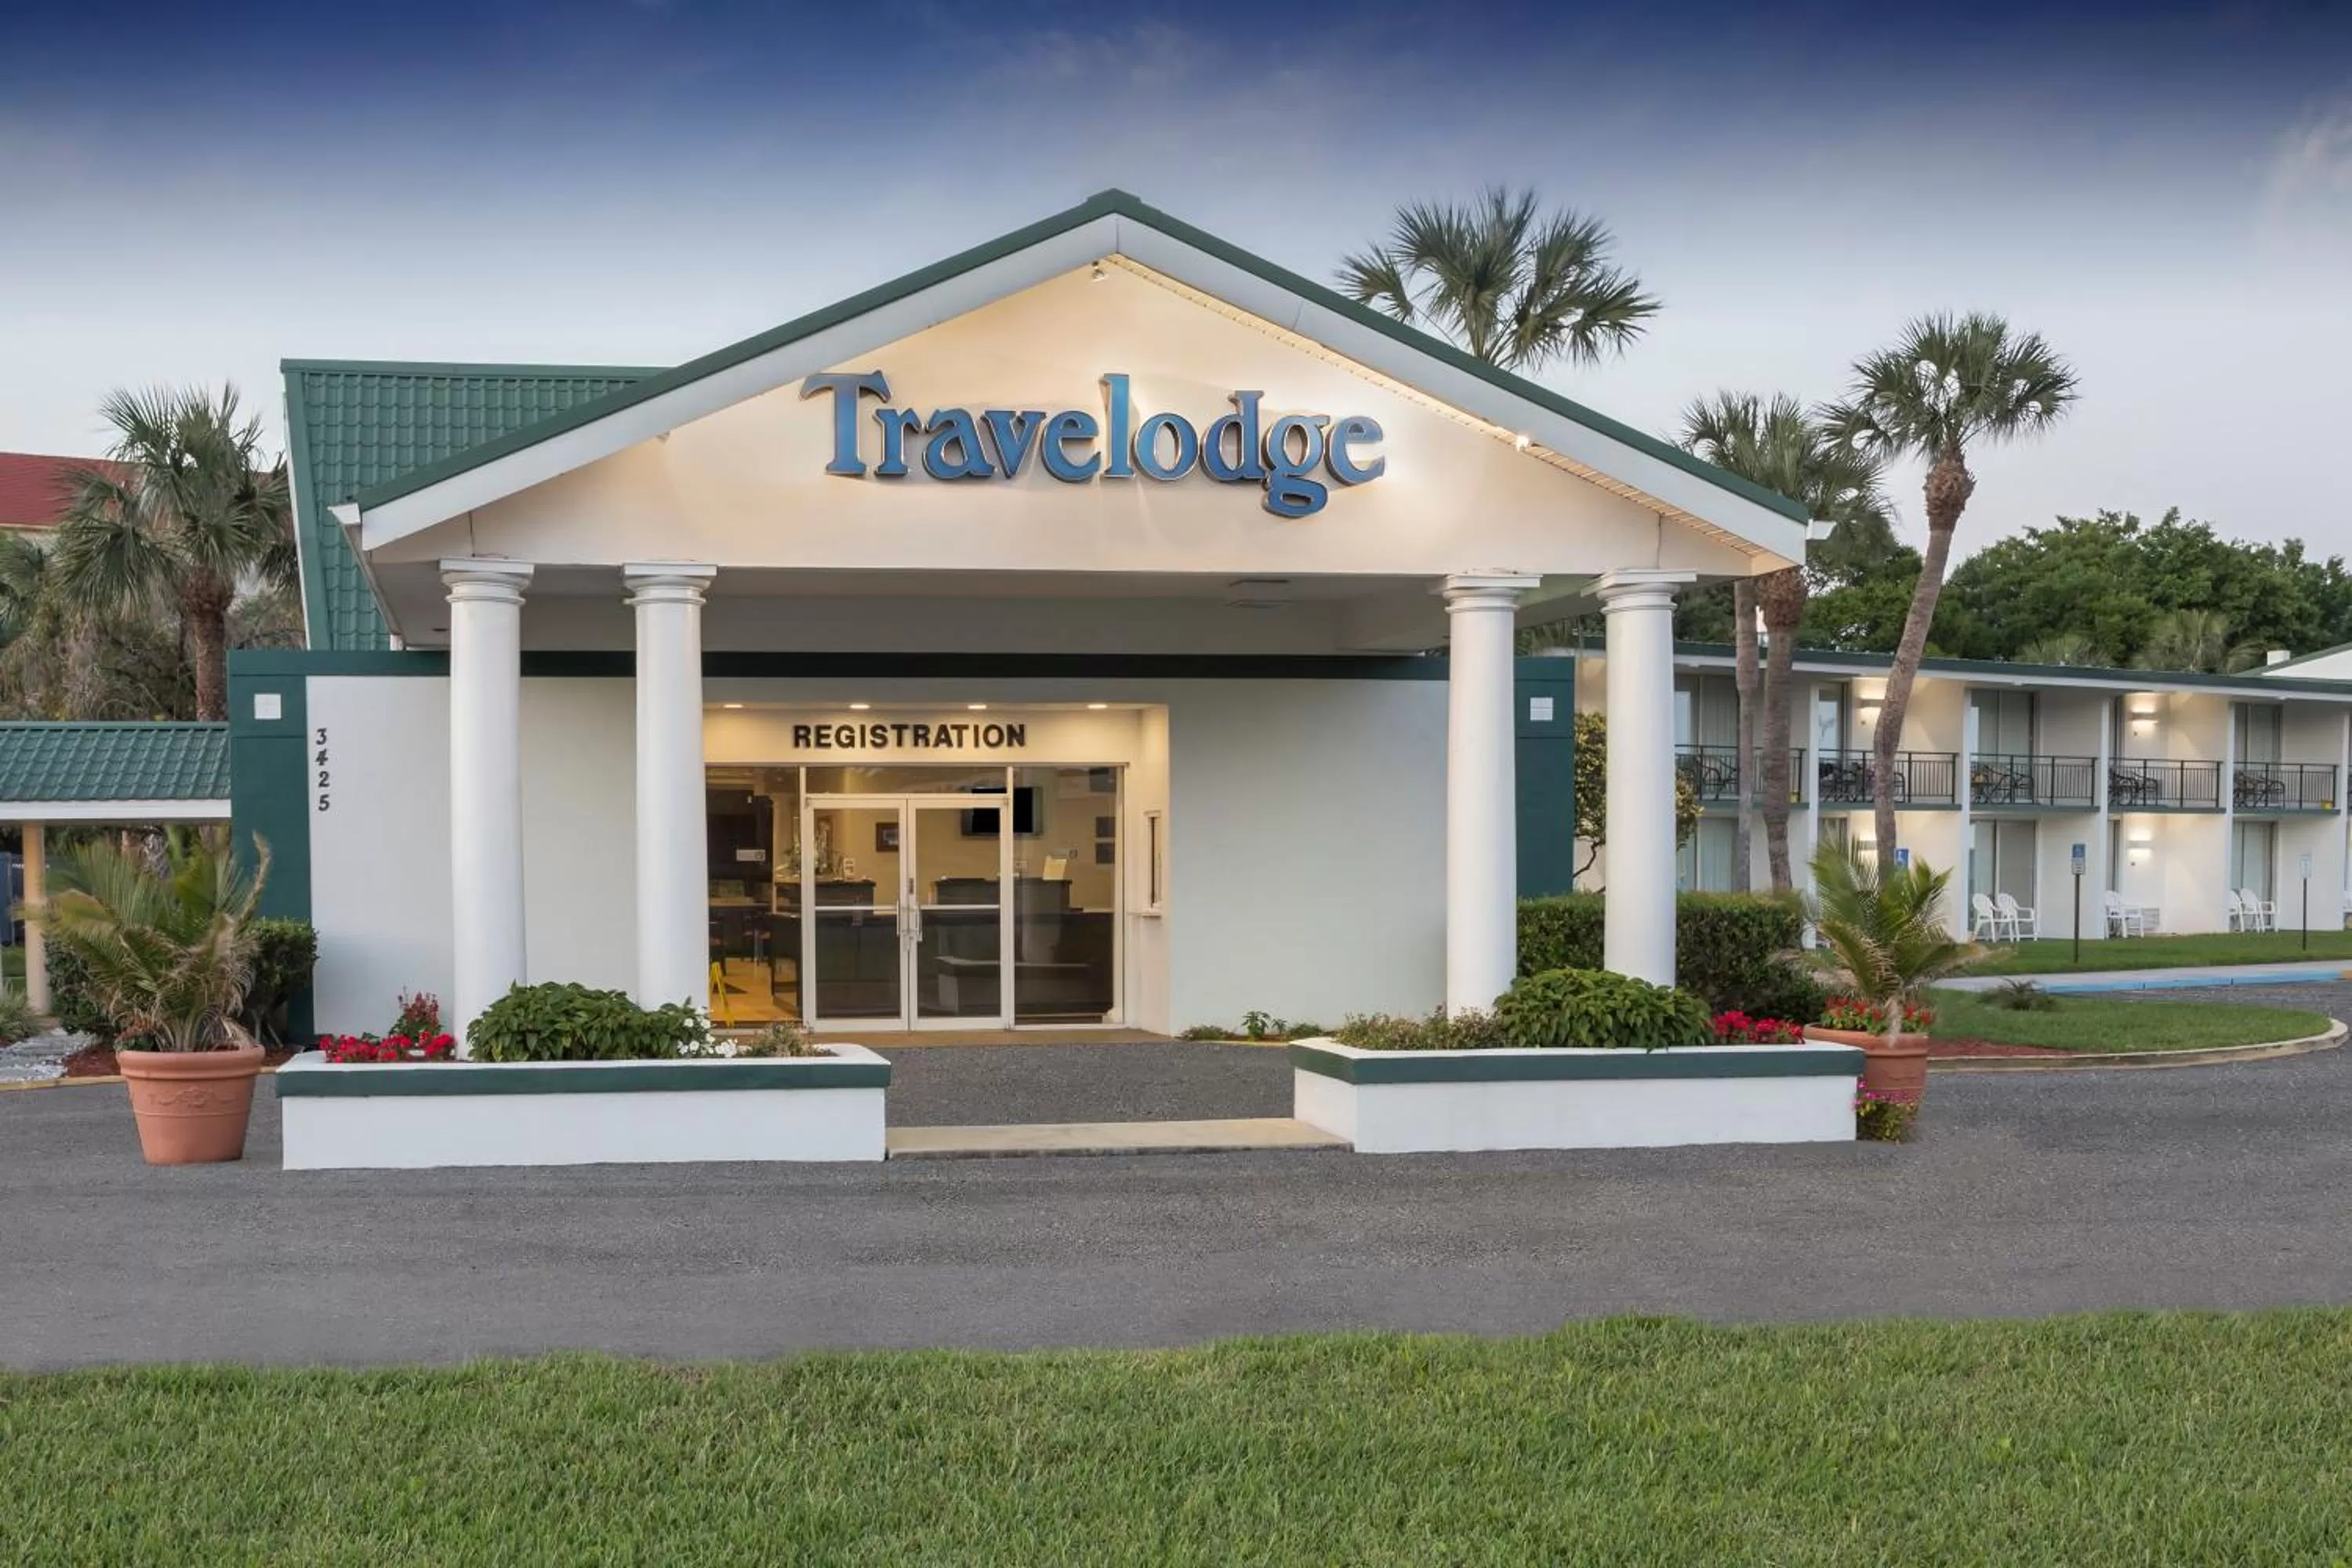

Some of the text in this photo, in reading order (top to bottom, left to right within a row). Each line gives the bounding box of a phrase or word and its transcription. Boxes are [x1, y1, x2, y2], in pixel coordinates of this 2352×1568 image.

[800, 370, 1385, 517] Travelodge
[315, 728, 330, 811] 3425
[793, 724, 1025, 750] REGISTRATION
